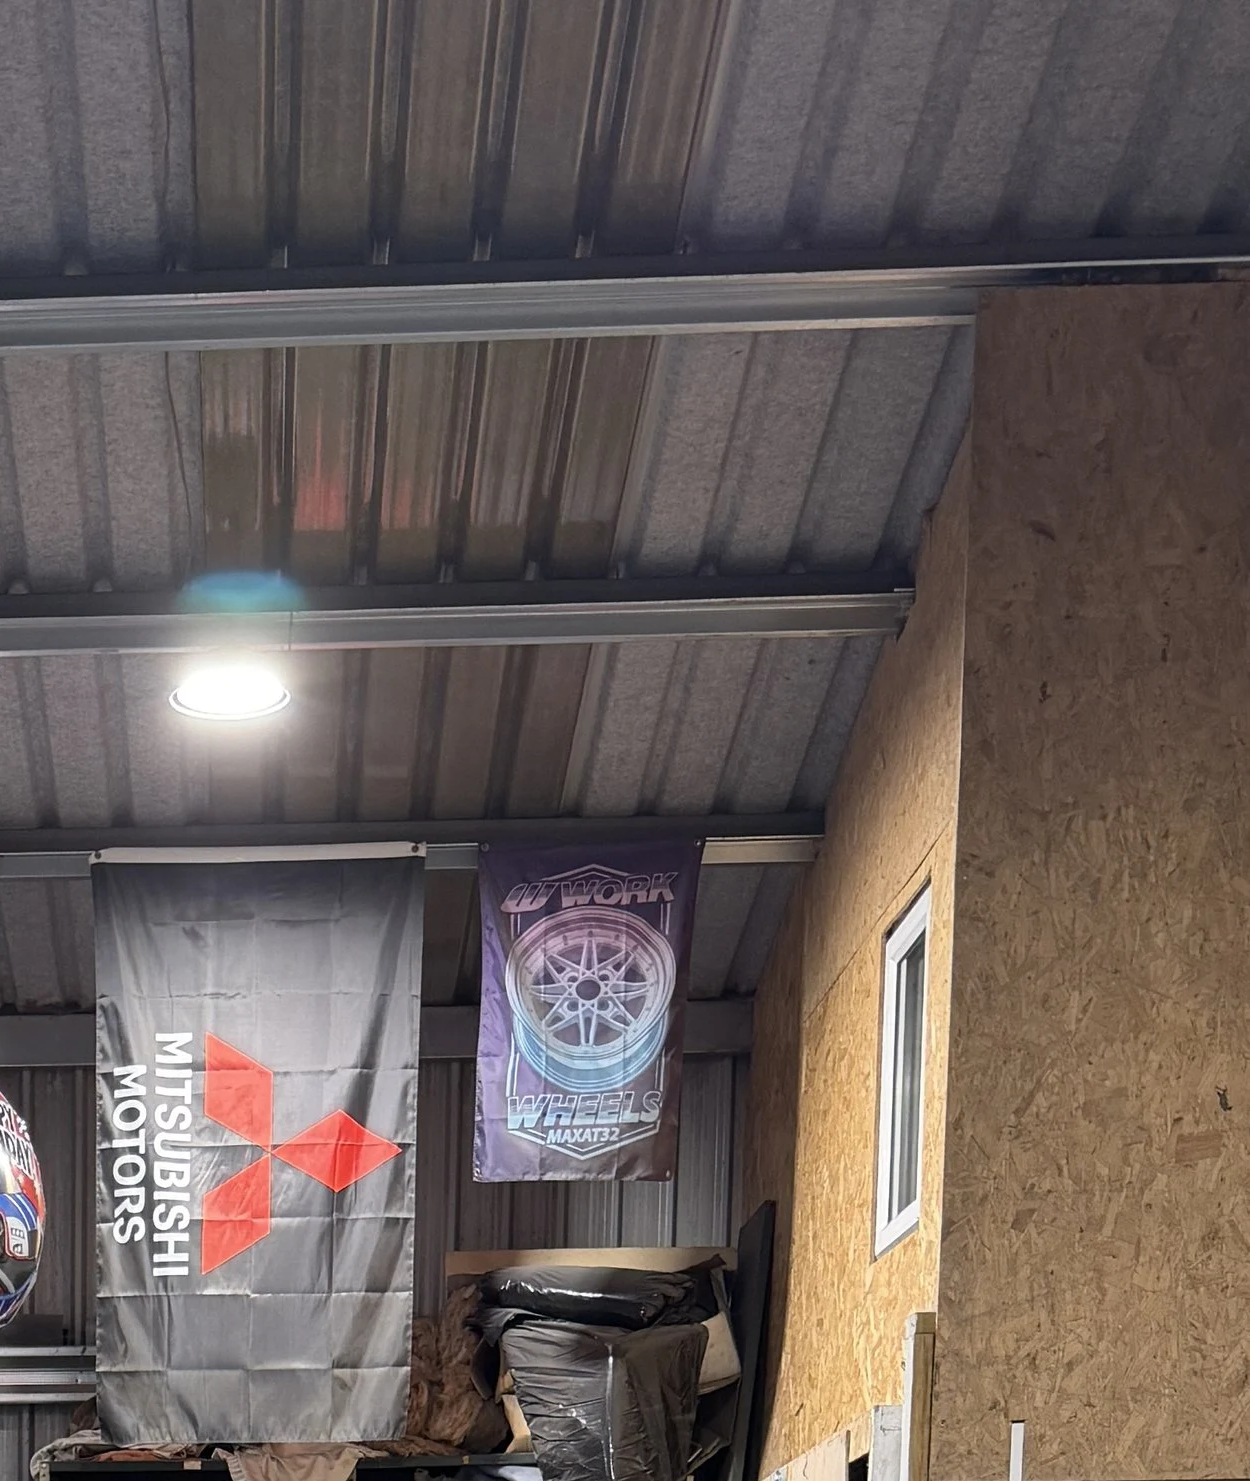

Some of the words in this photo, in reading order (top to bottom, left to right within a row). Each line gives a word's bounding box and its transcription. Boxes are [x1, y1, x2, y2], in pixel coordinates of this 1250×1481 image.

[561, 872, 678, 909] WORK
[507, 1091, 662, 1129] WHEELS
[111, 1064, 148, 1245] MOTORS
[152, 1032, 193, 1277] MITSUBISHI
[547, 1127, 620, 1144] MAXAT32
